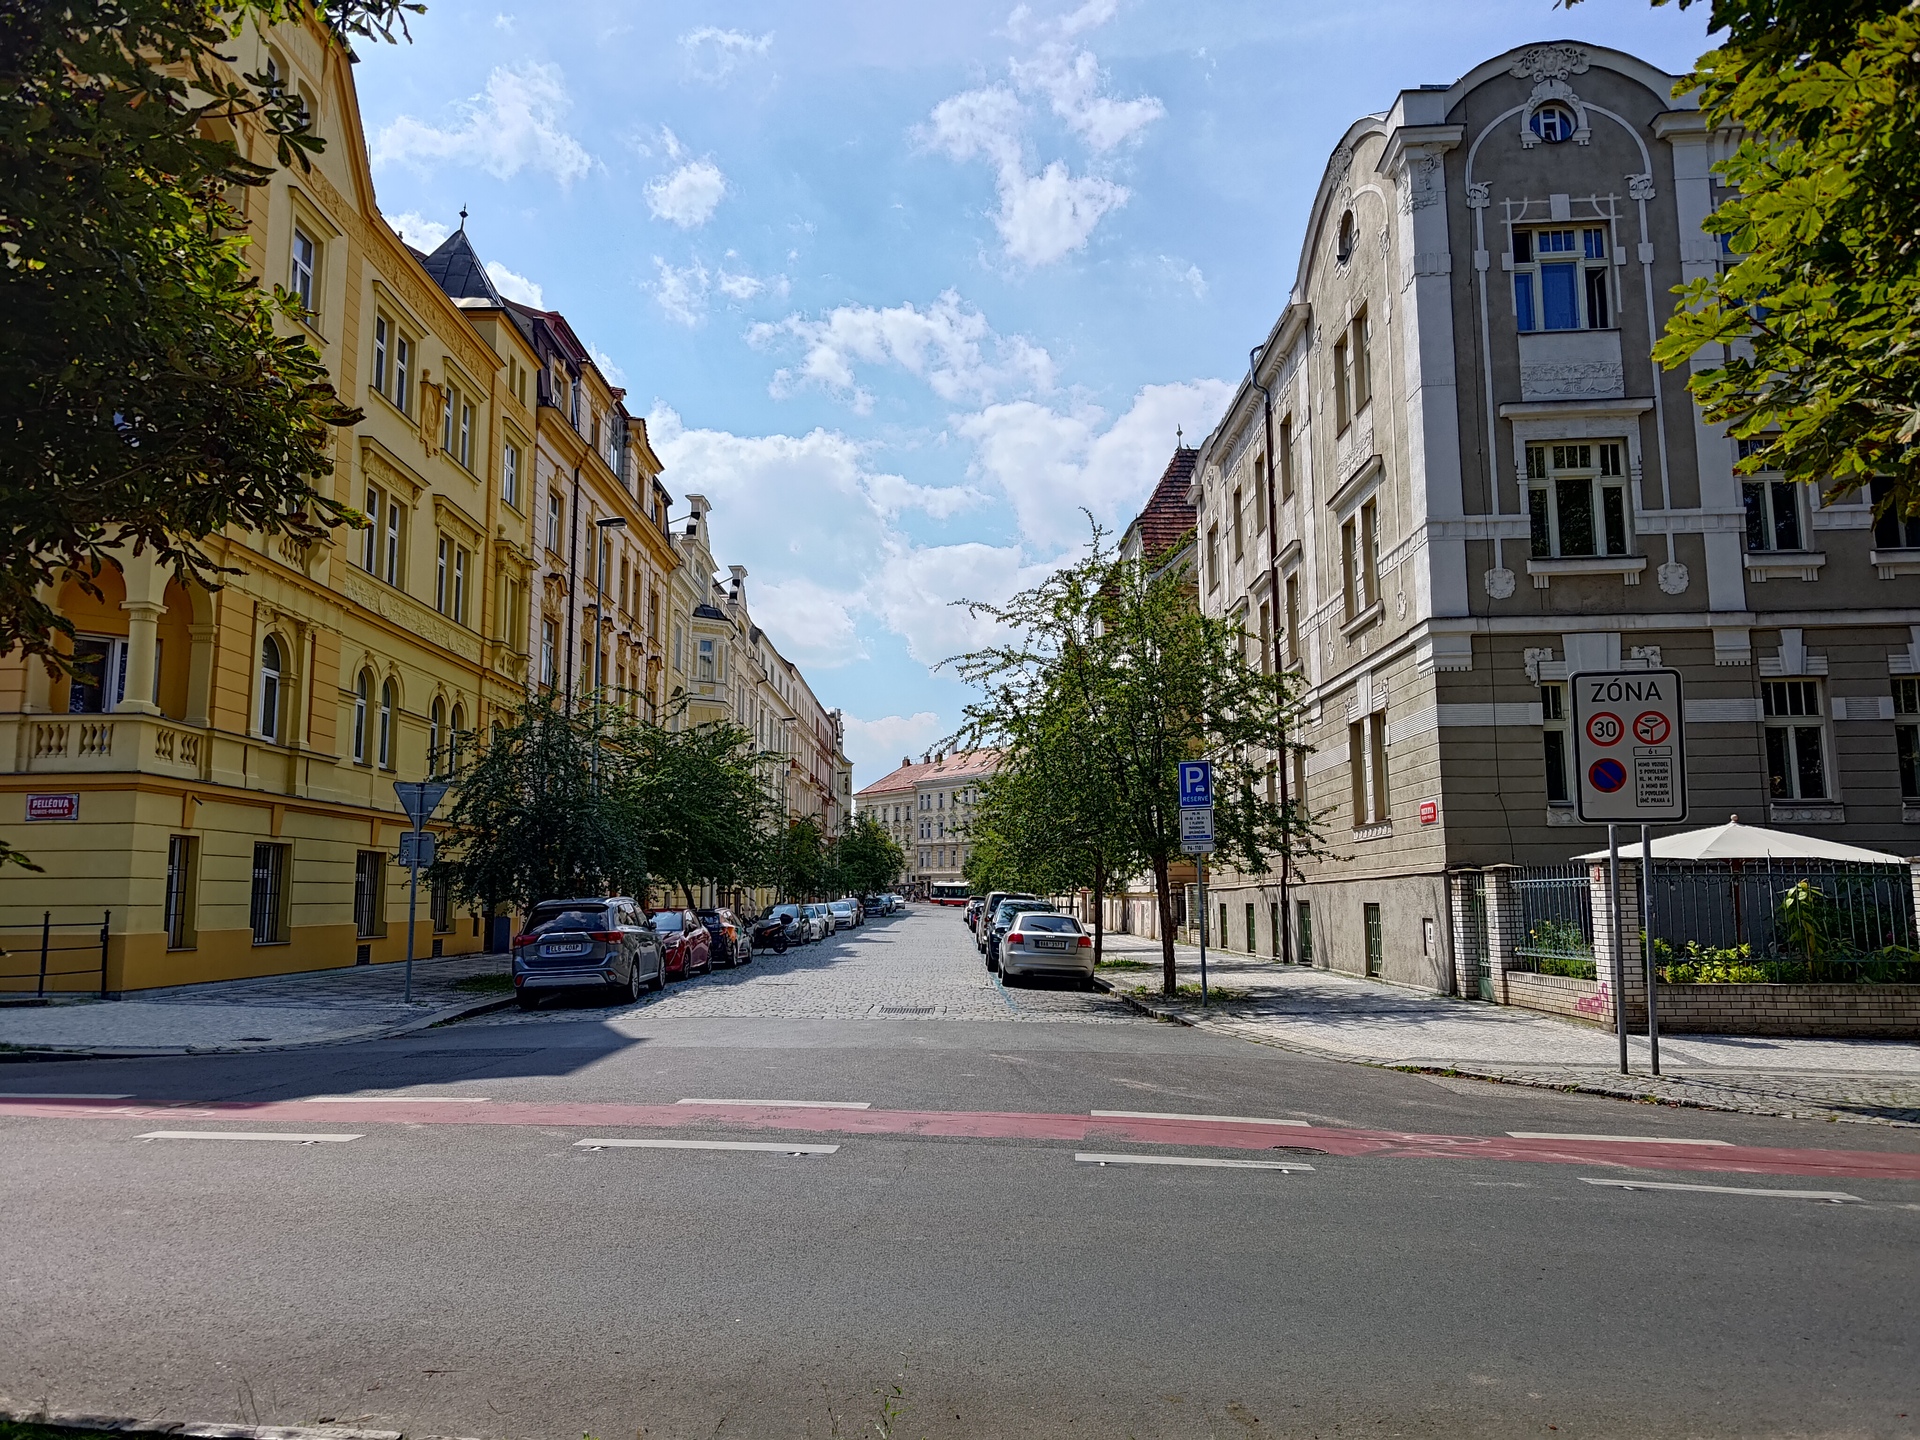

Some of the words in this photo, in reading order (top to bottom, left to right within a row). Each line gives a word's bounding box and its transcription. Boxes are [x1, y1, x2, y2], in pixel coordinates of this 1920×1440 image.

[1591, 678, 1662, 702] ZÓNA
[1594, 721, 1616, 737] 30
[32, 798, 68, 808] PELLÉOVA
